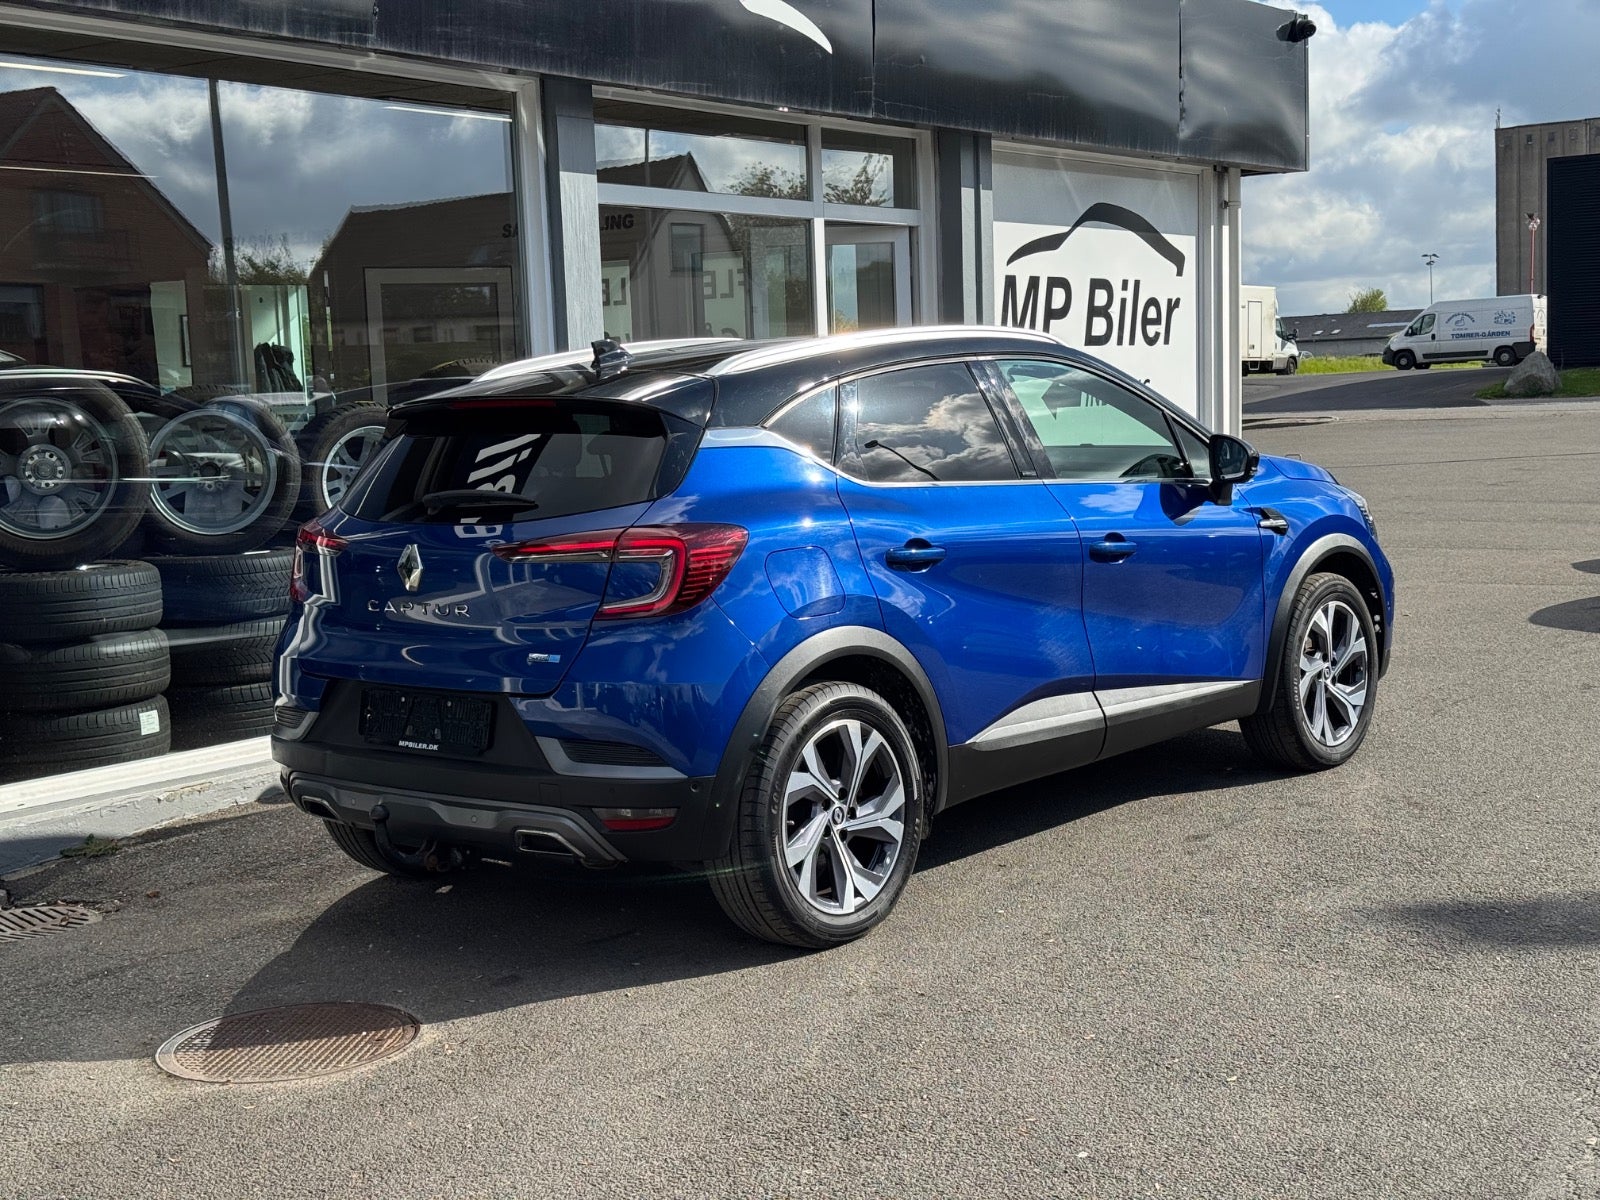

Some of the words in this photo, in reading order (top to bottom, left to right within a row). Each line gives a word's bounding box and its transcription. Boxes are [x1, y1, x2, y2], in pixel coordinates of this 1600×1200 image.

[1001, 275, 1072, 334] MP
[1084, 278, 1181, 347] Biler
[367, 599, 470, 617] CAPTUR
[398, 740, 439, 751] MPBILER.DK
